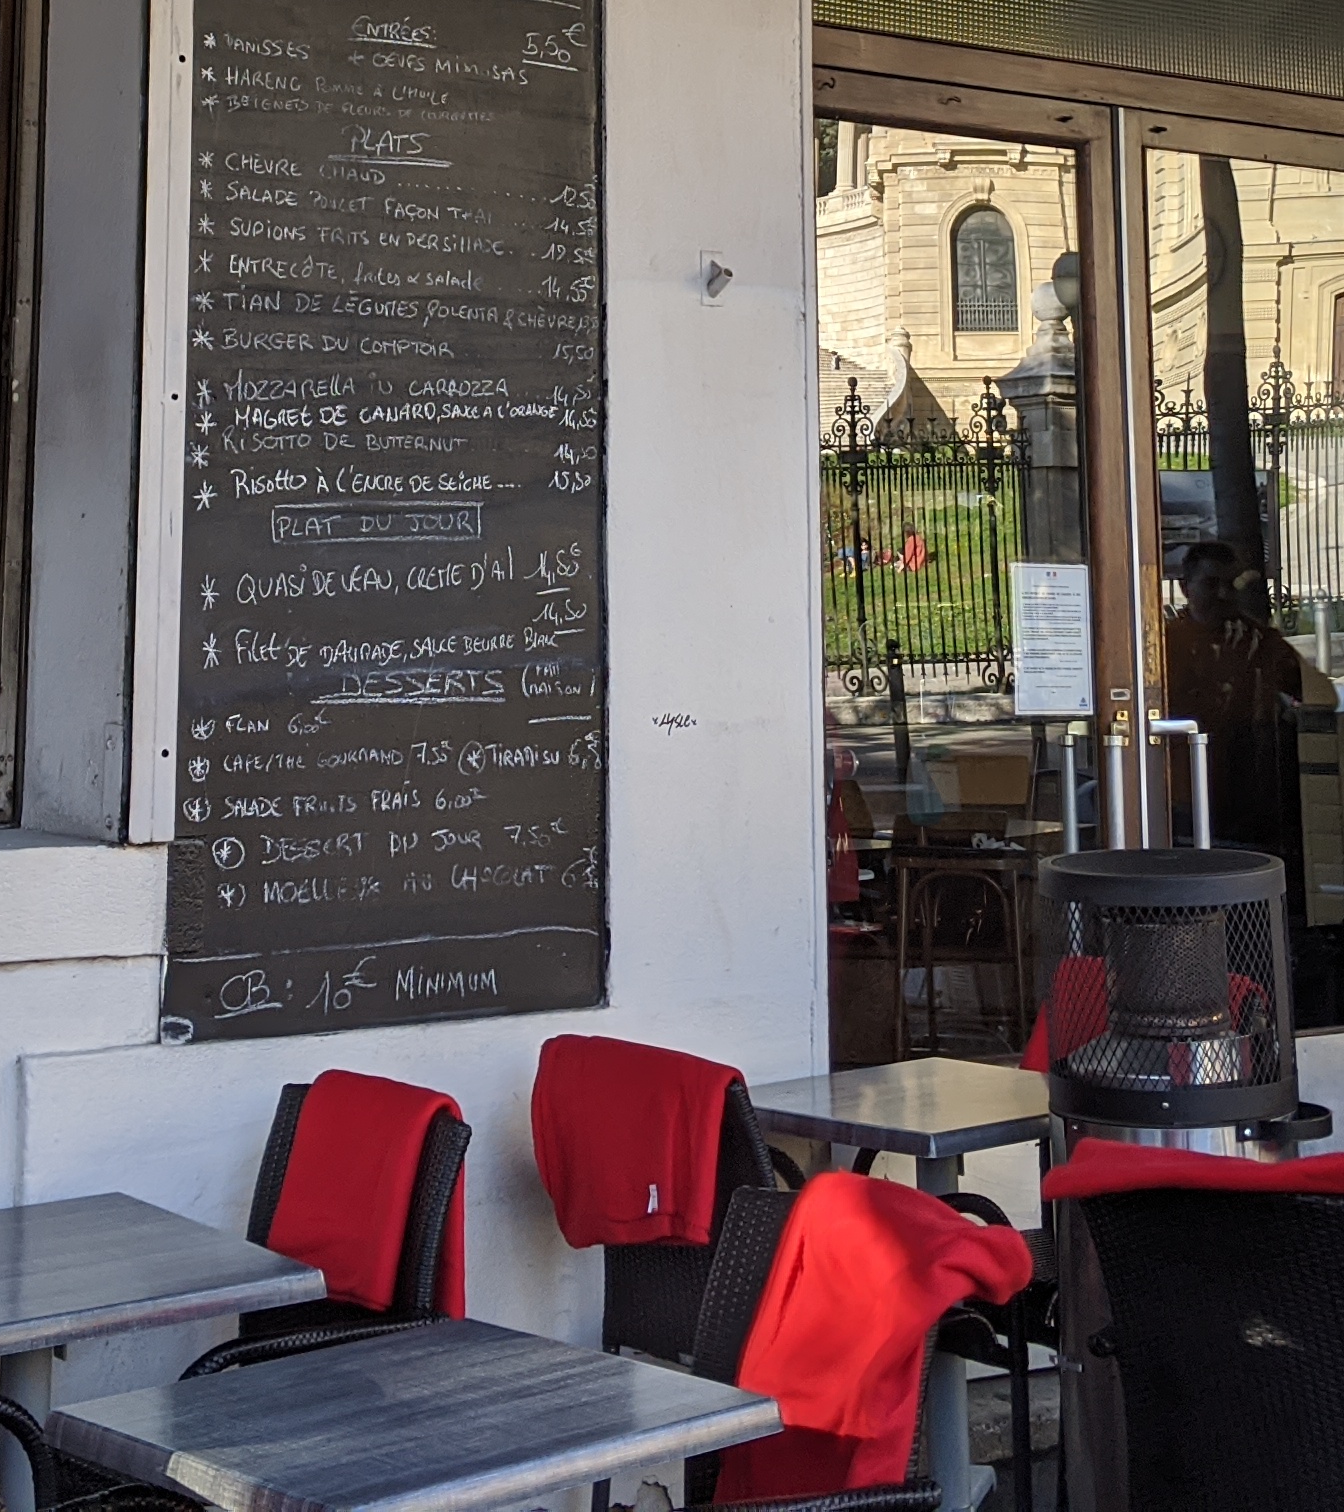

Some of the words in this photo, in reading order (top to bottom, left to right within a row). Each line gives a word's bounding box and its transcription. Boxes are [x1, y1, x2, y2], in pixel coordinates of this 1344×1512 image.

[225, 65, 302, 92] HARENG
[341, 124, 432, 156] PLATS
[225, 180, 299, 207] SALADE
[295, 292, 324, 313] DE
[221, 327, 315, 353] BURGER
[321, 334, 350, 353] DU
[359, 337, 455, 359] COMPTOIR
[319, 403, 349, 427] DE
[221, 424, 312, 454] RISOTTO
[323, 431, 356, 451] DE
[408, 474, 435, 494] DE
[275, 514, 342, 539] PLAT
[359, 513, 393, 533] DU
[404, 510, 476, 535] JOUR
[236, 563, 307, 606] QUASI
[312, 569, 337, 598] DE
[285, 643, 314, 668] DE
[322, 668, 505, 699] DESSERTS
[225, 713, 270, 734] FLAN
[221, 795, 284, 821] SALADE
[292, 793, 358, 818] FRUTS
[259, 832, 368, 865] DESSERT
[430, 828, 483, 852] JOUR
[394, 964, 498, 1002] MINIMUM
